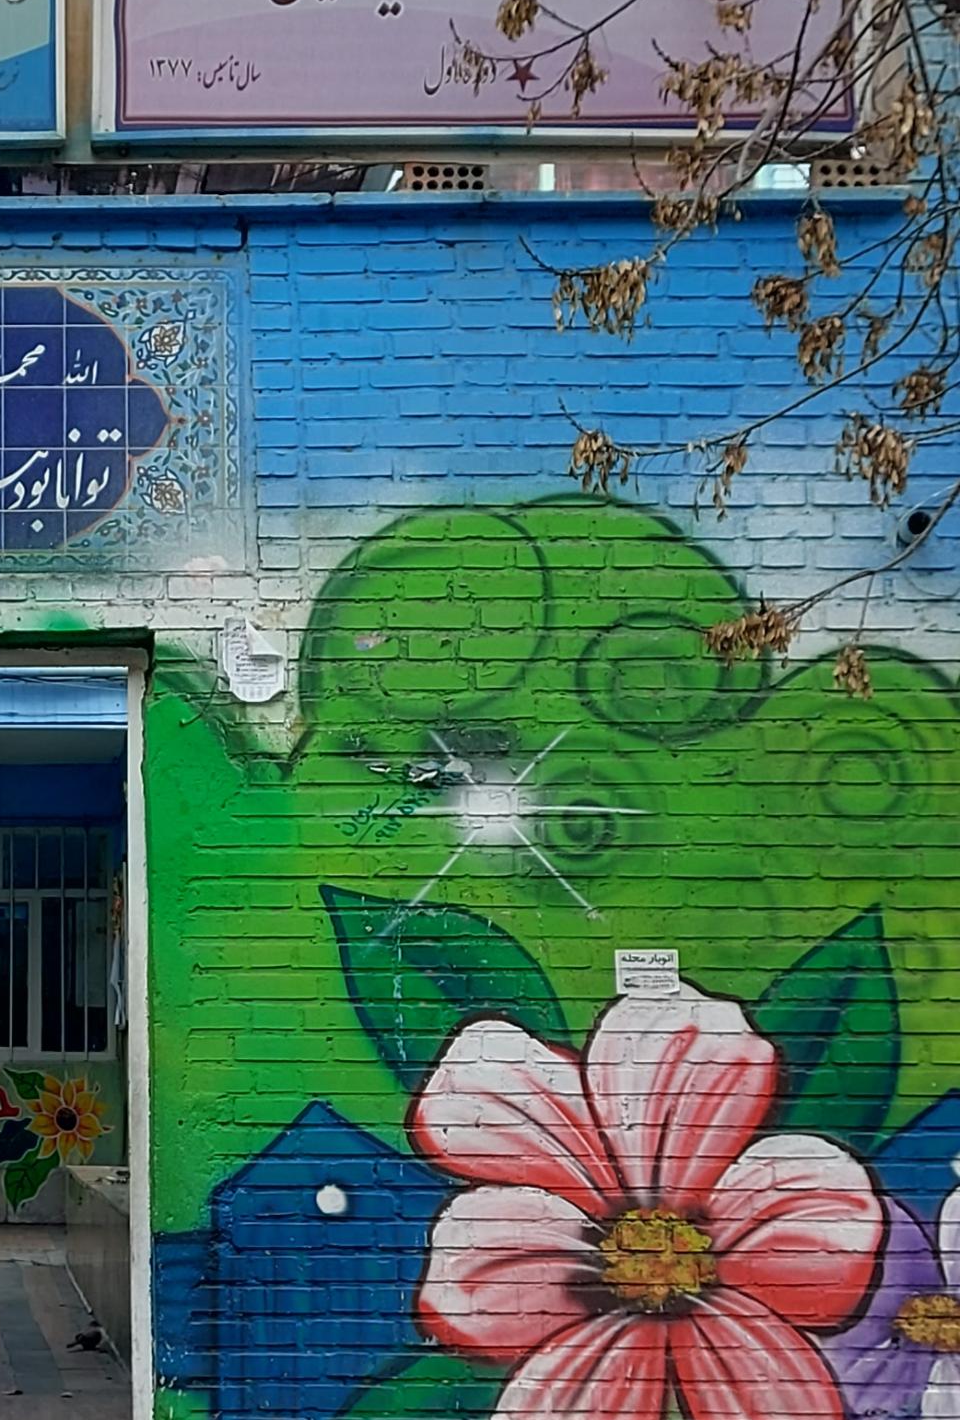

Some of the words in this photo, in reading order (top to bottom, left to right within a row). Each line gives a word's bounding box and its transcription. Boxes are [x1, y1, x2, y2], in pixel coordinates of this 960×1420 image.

[149, 59, 192, 78] ۱۳۷۷
[236, 61, 261, 91] سال
[56, 428, 122, 509] توانا
[8, 468, 50, 532] بود
[621, 953, 646, 963] محله
